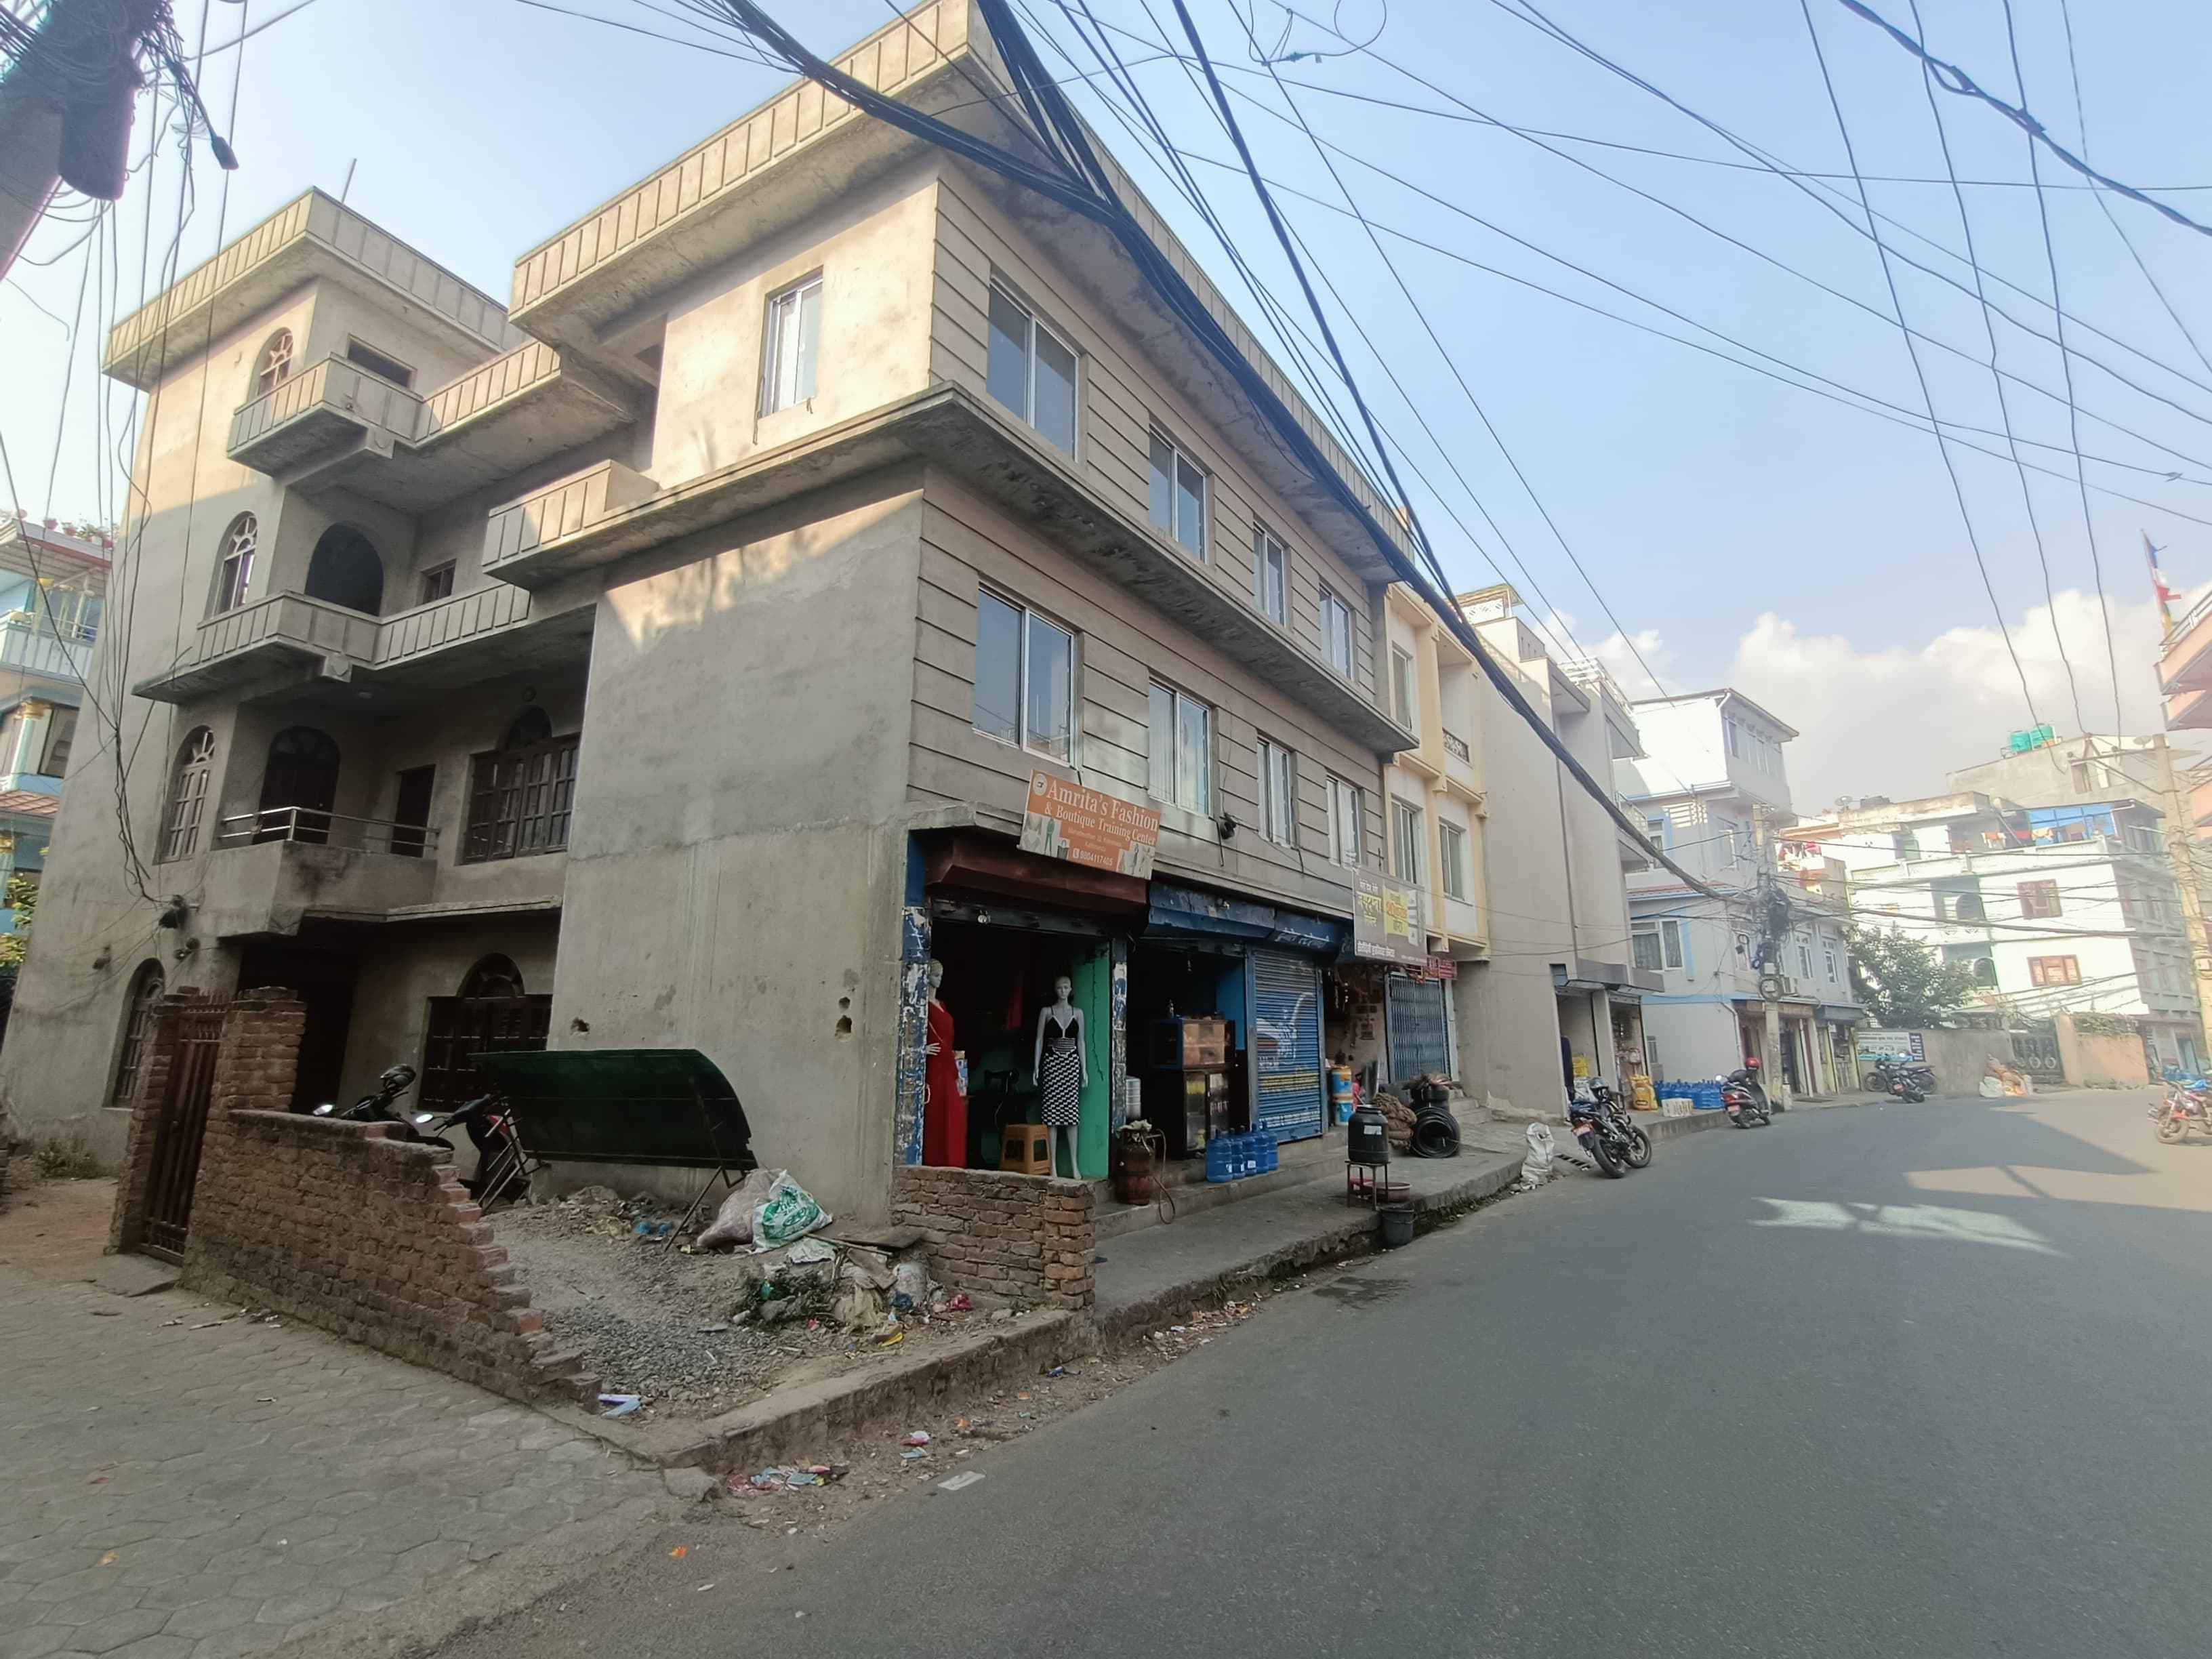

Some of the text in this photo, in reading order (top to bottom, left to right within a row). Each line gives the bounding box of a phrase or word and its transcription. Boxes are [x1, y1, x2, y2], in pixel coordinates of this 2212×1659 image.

[1044, 802, 1052, 815] &
[1057, 804, 1095, 828] Boutique
[1098, 818, 1130, 842] Training
[1132, 829, 1156, 845] Center
[1046, 780, 1158, 832] Amrita's Fashion
